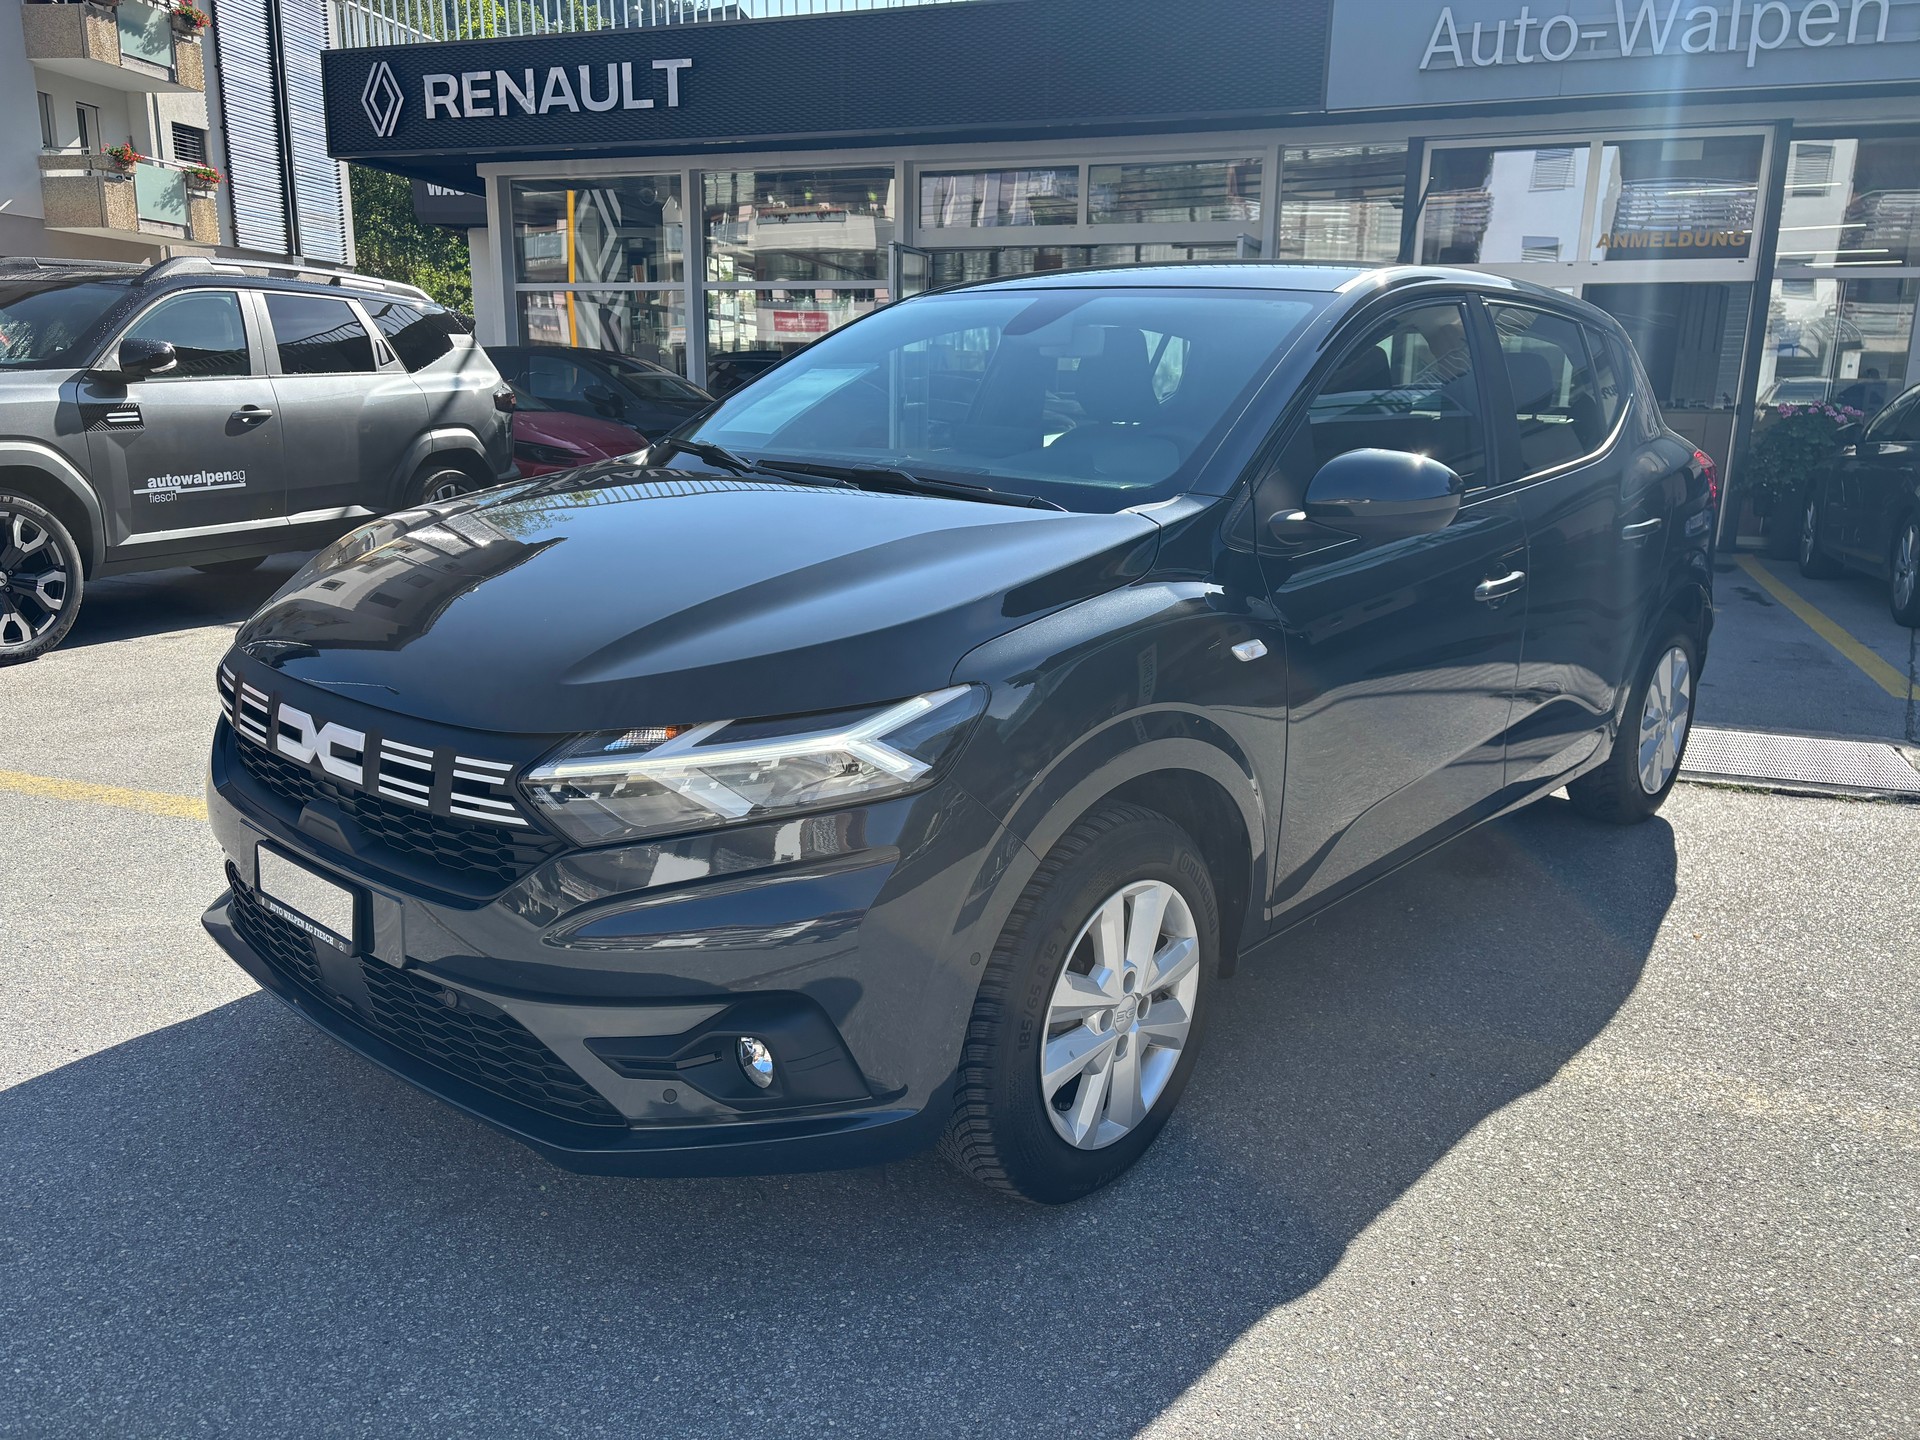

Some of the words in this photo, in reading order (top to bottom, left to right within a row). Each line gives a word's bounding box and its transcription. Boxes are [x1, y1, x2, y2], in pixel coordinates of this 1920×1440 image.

[1419, 0, 1891, 71] Auto-Walpen
[422, 58, 693, 120] RENAULT
[1596, 230, 1746, 249] ANMELDUNG
[149, 490, 177, 504] fiesch
[269, 902, 284, 917] AUTO
[283, 910, 305, 929] WALPEN
[305, 923, 313, 935] AG
[313, 926, 334, 946] FIESCH
[1017, 984, 1042, 1053] 185/65
